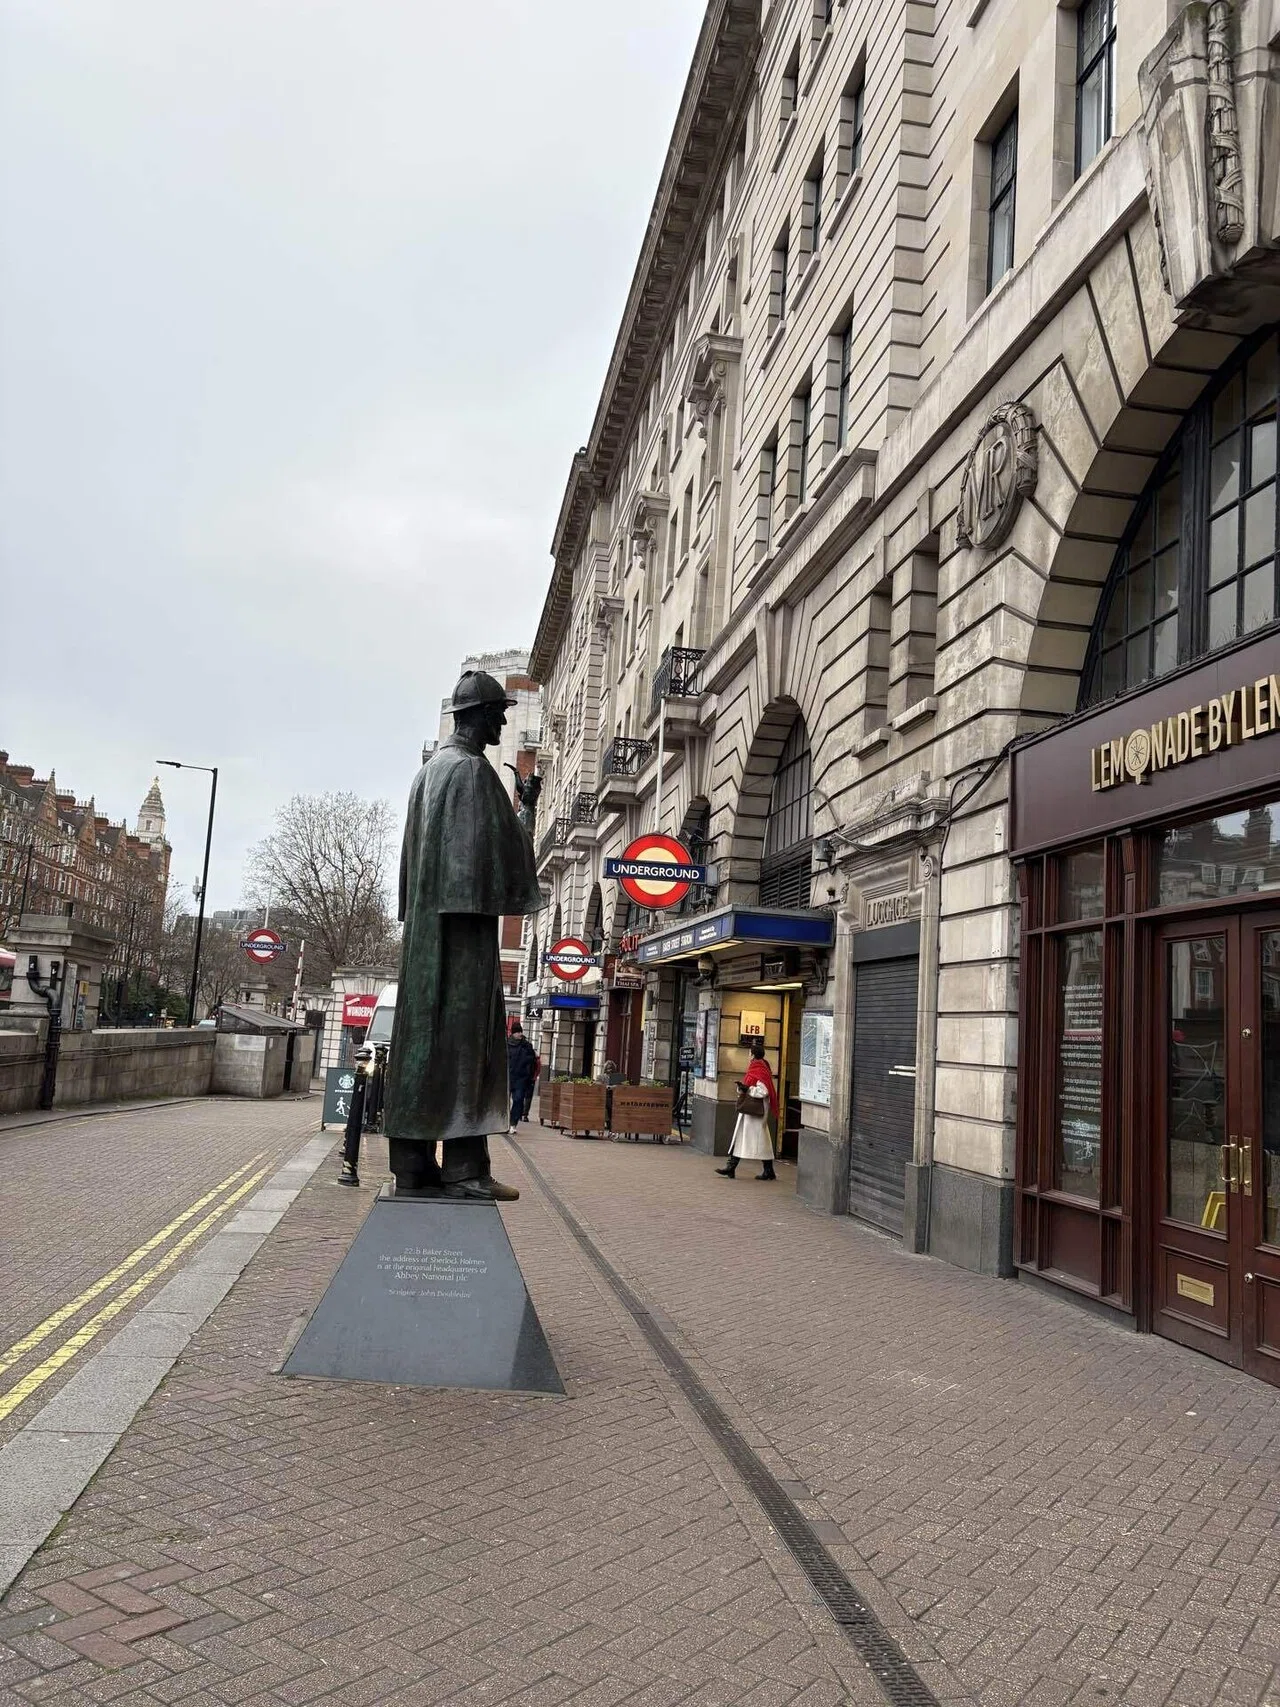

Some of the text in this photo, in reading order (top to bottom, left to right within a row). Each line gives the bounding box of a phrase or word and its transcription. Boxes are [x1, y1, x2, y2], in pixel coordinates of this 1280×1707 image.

[1092, 705, 1203, 792] LEMONADE
[1208, 690, 1236, 751] BY
[612, 863, 700, 880] UNDERGROUND
[867, 896, 909, 927] LUGGAGE
[241, 942, 284, 950] UNDERGROUND
[546, 955, 596, 964] UNDERGROUND
[745, 1025, 760, 1034] LFB
[422, 1248, 441, 1256] Baker
[443, 1249, 463, 1257] Street
[393, 1255, 419, 1263] address
[430, 1257, 458, 1265] Sherlock
[460, 1258, 485, 1266] Holmes
[405, 1264, 431, 1272] original
[433, 1264, 478, 1274] headquarters
[394, 1271, 419, 1280] Abbey
[421, 1272, 454, 1281] National
